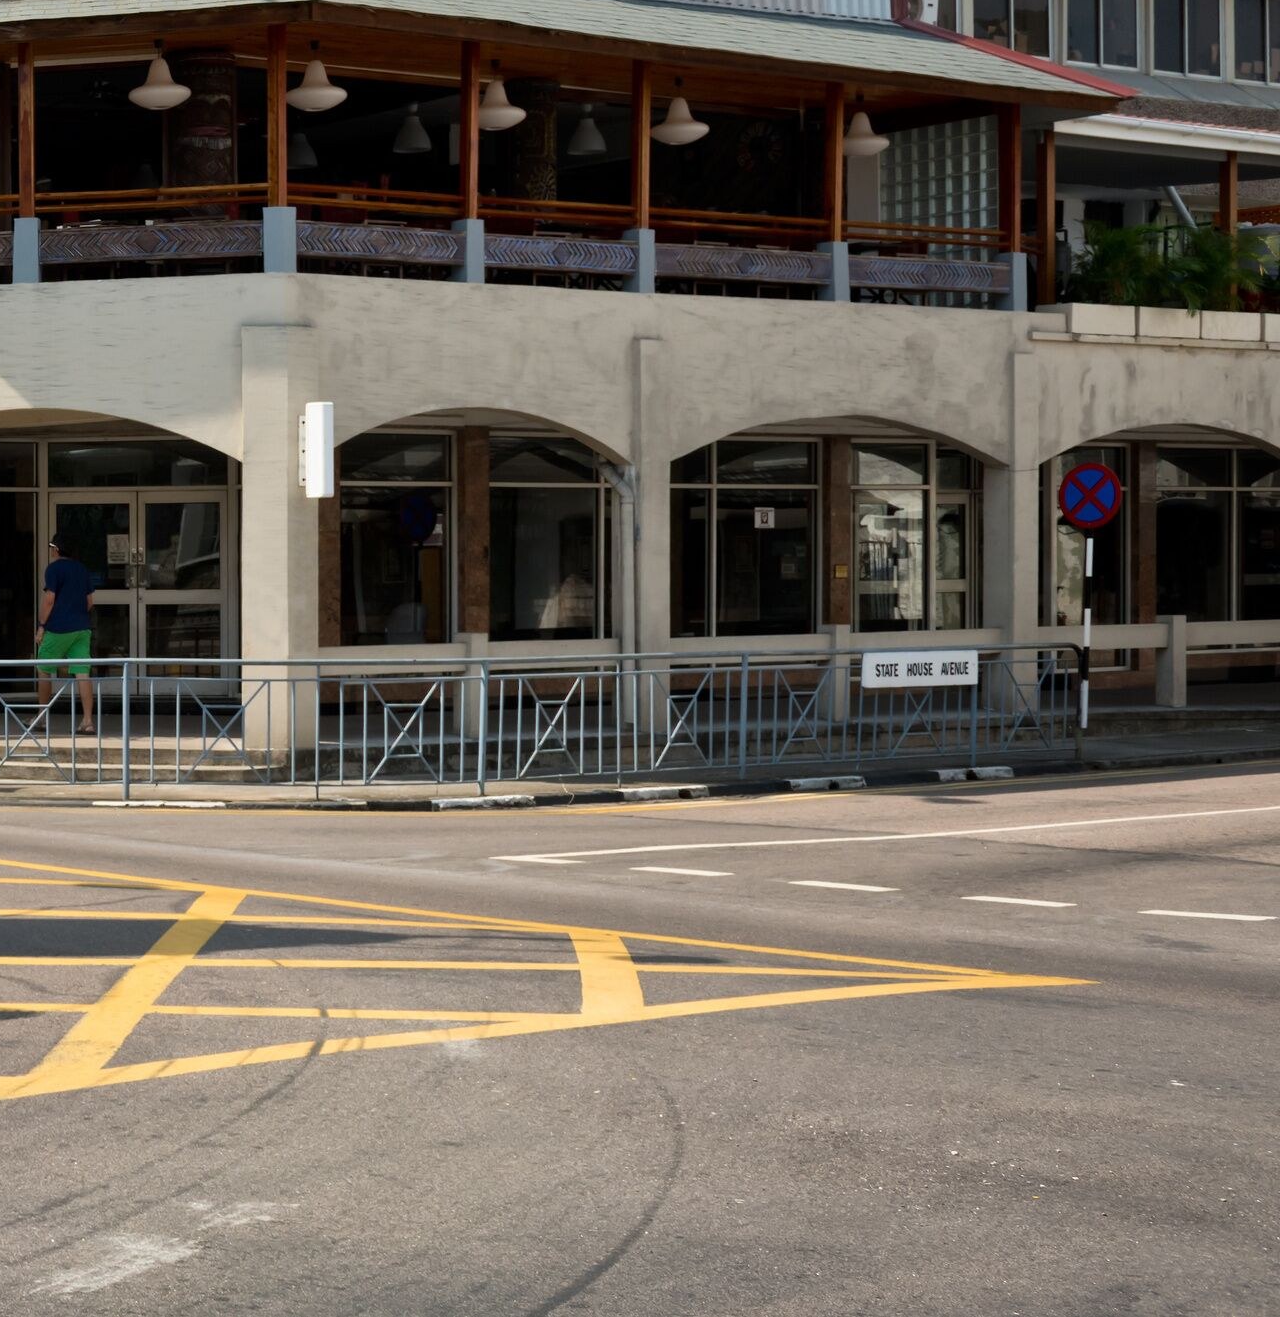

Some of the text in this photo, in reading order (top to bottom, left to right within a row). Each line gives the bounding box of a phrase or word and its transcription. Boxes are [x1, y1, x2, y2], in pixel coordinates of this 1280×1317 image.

[875, 662, 969, 677] STATE HOUSE AVENUE
